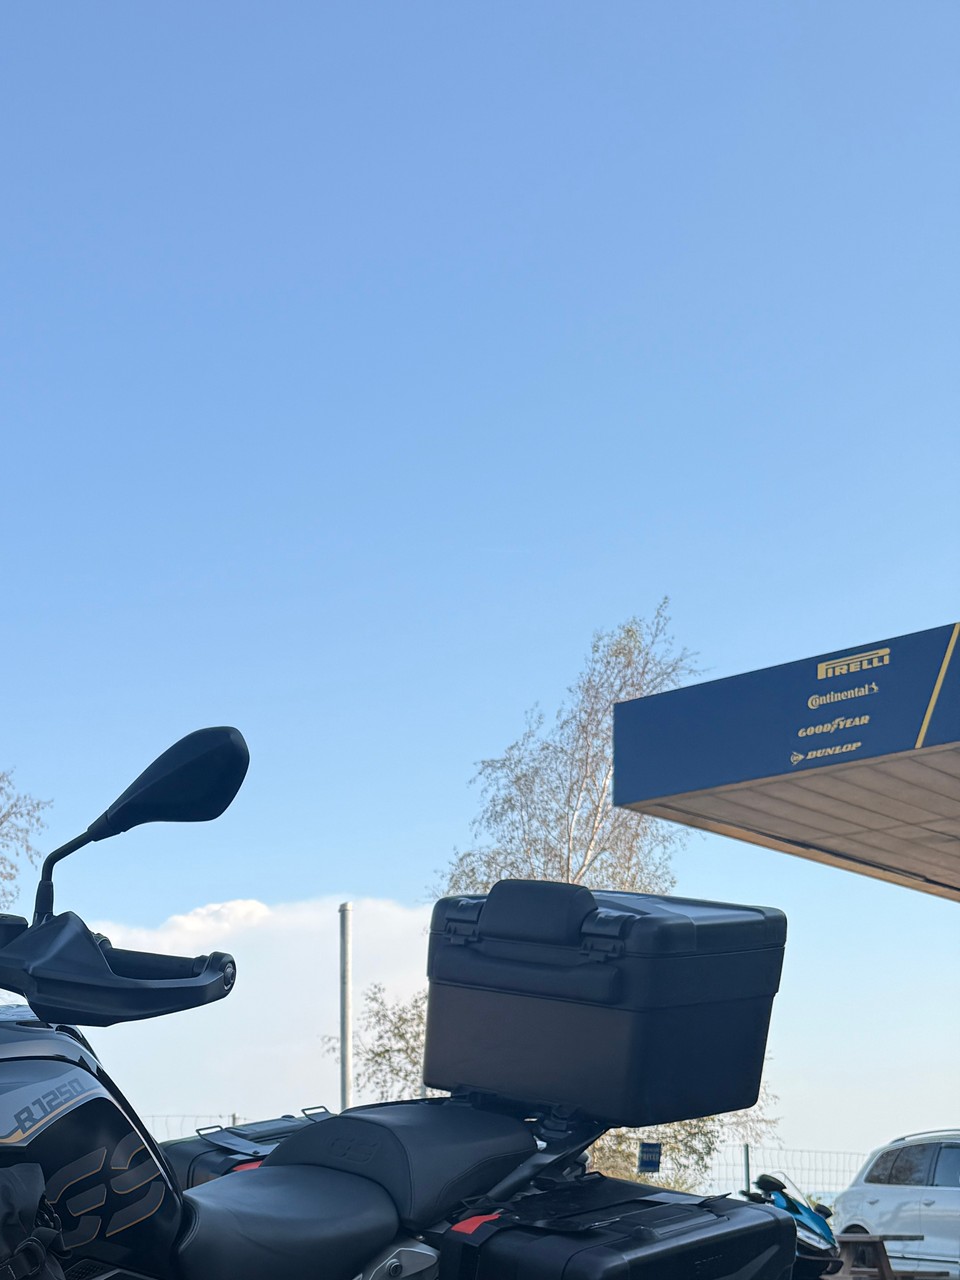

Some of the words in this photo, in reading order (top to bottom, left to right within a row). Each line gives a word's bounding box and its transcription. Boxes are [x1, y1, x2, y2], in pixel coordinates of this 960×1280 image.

[817, 648, 891, 680] PIRELLI
[807, 683, 869, 710] Continental
[797, 715, 870, 738] GOODYEAR
[805, 741, 862, 760] DUNLOP
